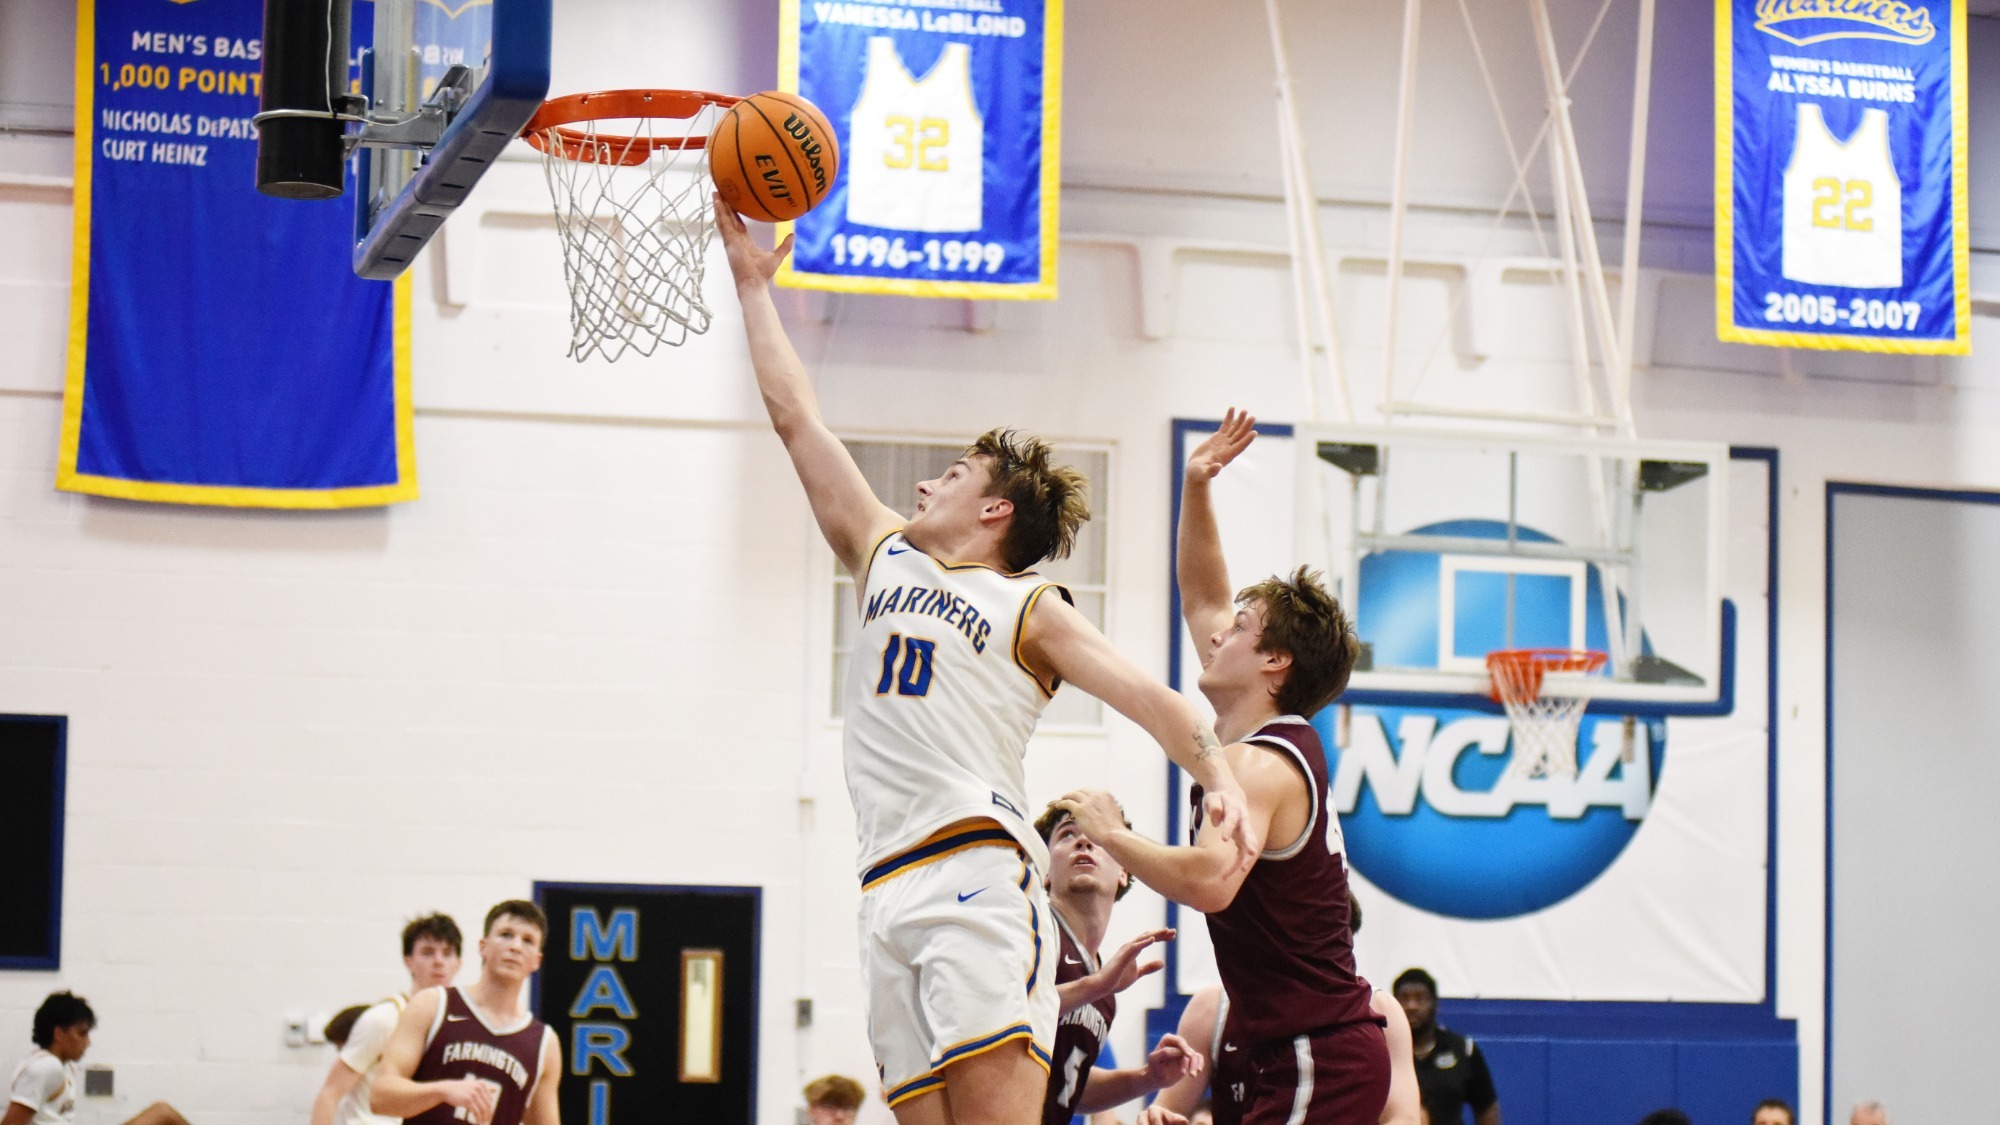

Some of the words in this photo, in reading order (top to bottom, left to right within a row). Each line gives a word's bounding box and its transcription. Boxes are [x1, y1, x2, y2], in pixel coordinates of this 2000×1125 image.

[814, 2, 919, 31] VANESSA
[922, 10, 1026, 38] LeBLOND
[132, 30, 207, 56] MEN'S
[100, 62, 170, 91] 1,000
[178, 67, 262, 97] POINT
[1767, 71, 1846, 98] ALYSSA
[1848, 79, 1915, 103] BURNS
[1769, 54, 1831, 75] WOMEN'S
[1832, 60, 1915, 82] BASKETBALL
[102, 108, 192, 136] NICHOLAS
[102, 138, 147, 162] CURT
[152, 142, 208, 167] HEINZ
[783, 112, 827, 195] Wilson
[883, 115, 949, 172] 32
[1811, 176, 1873, 232] 22
[830, 233, 1005, 274] 1996-1999
[1764, 291, 1921, 331] 2005-2007
[863, 586, 991, 655] MARINERS
[875, 632, 938, 699] 10
[1332, 714, 1650, 819] NCAA
[570, 907, 639, 1125] MARI
[442, 1041, 528, 1091] FARMINGTON
